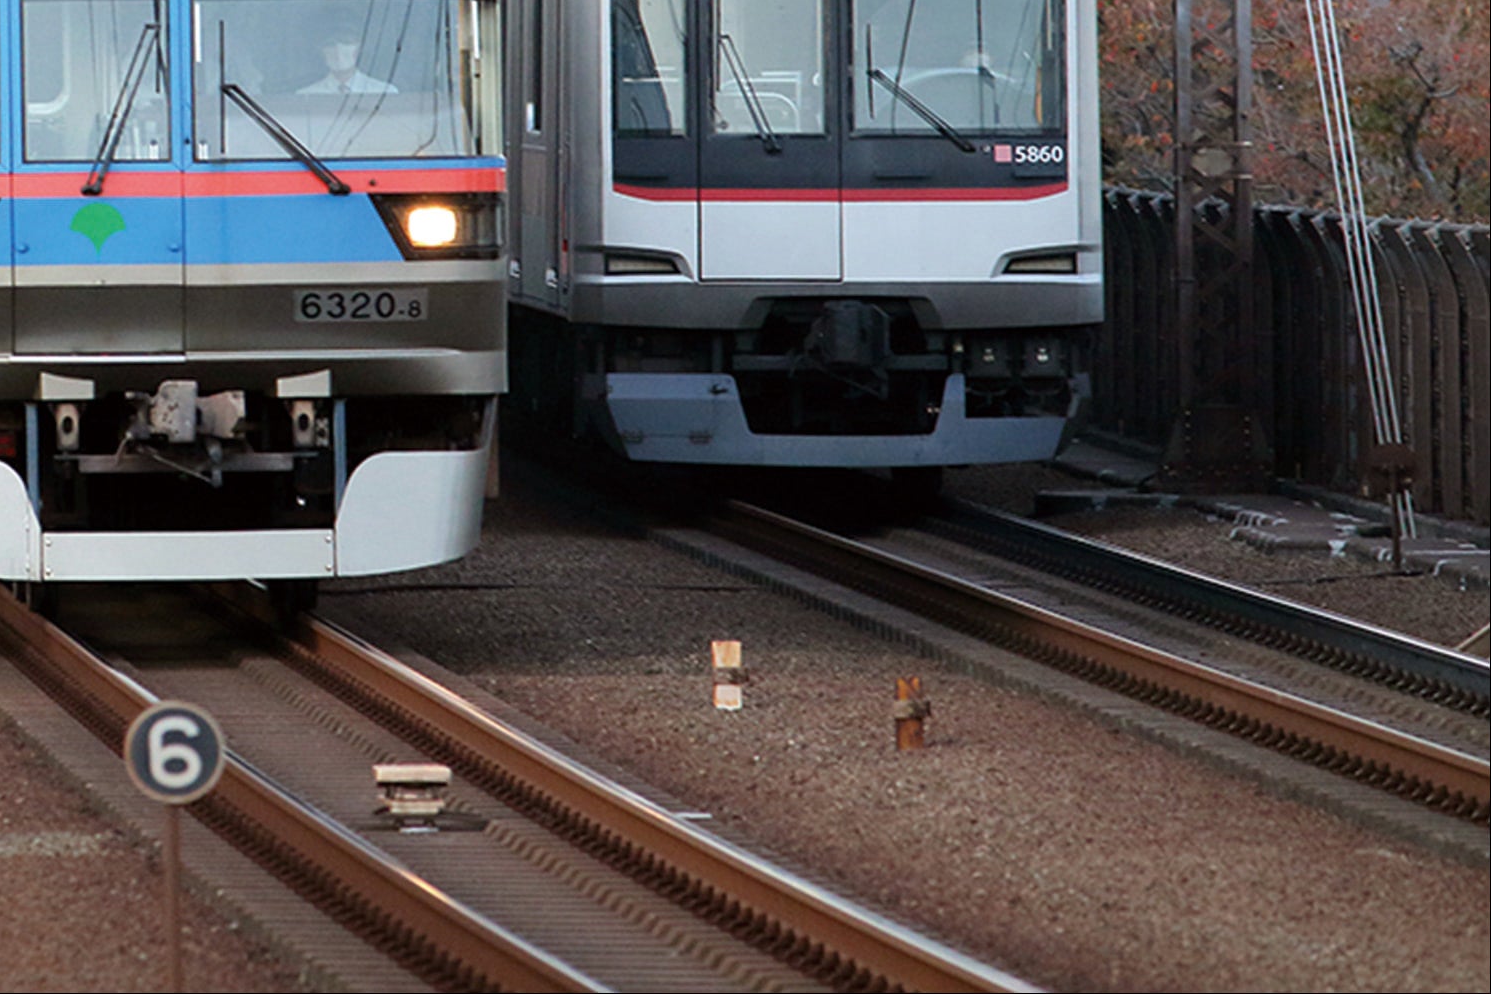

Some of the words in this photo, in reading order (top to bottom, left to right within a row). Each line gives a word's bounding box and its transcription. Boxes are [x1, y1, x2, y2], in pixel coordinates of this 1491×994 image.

[1014, 145, 1064, 163] 5860
[300, 292, 422, 319] 6320-8
[148, 715, 203, 789] 6
